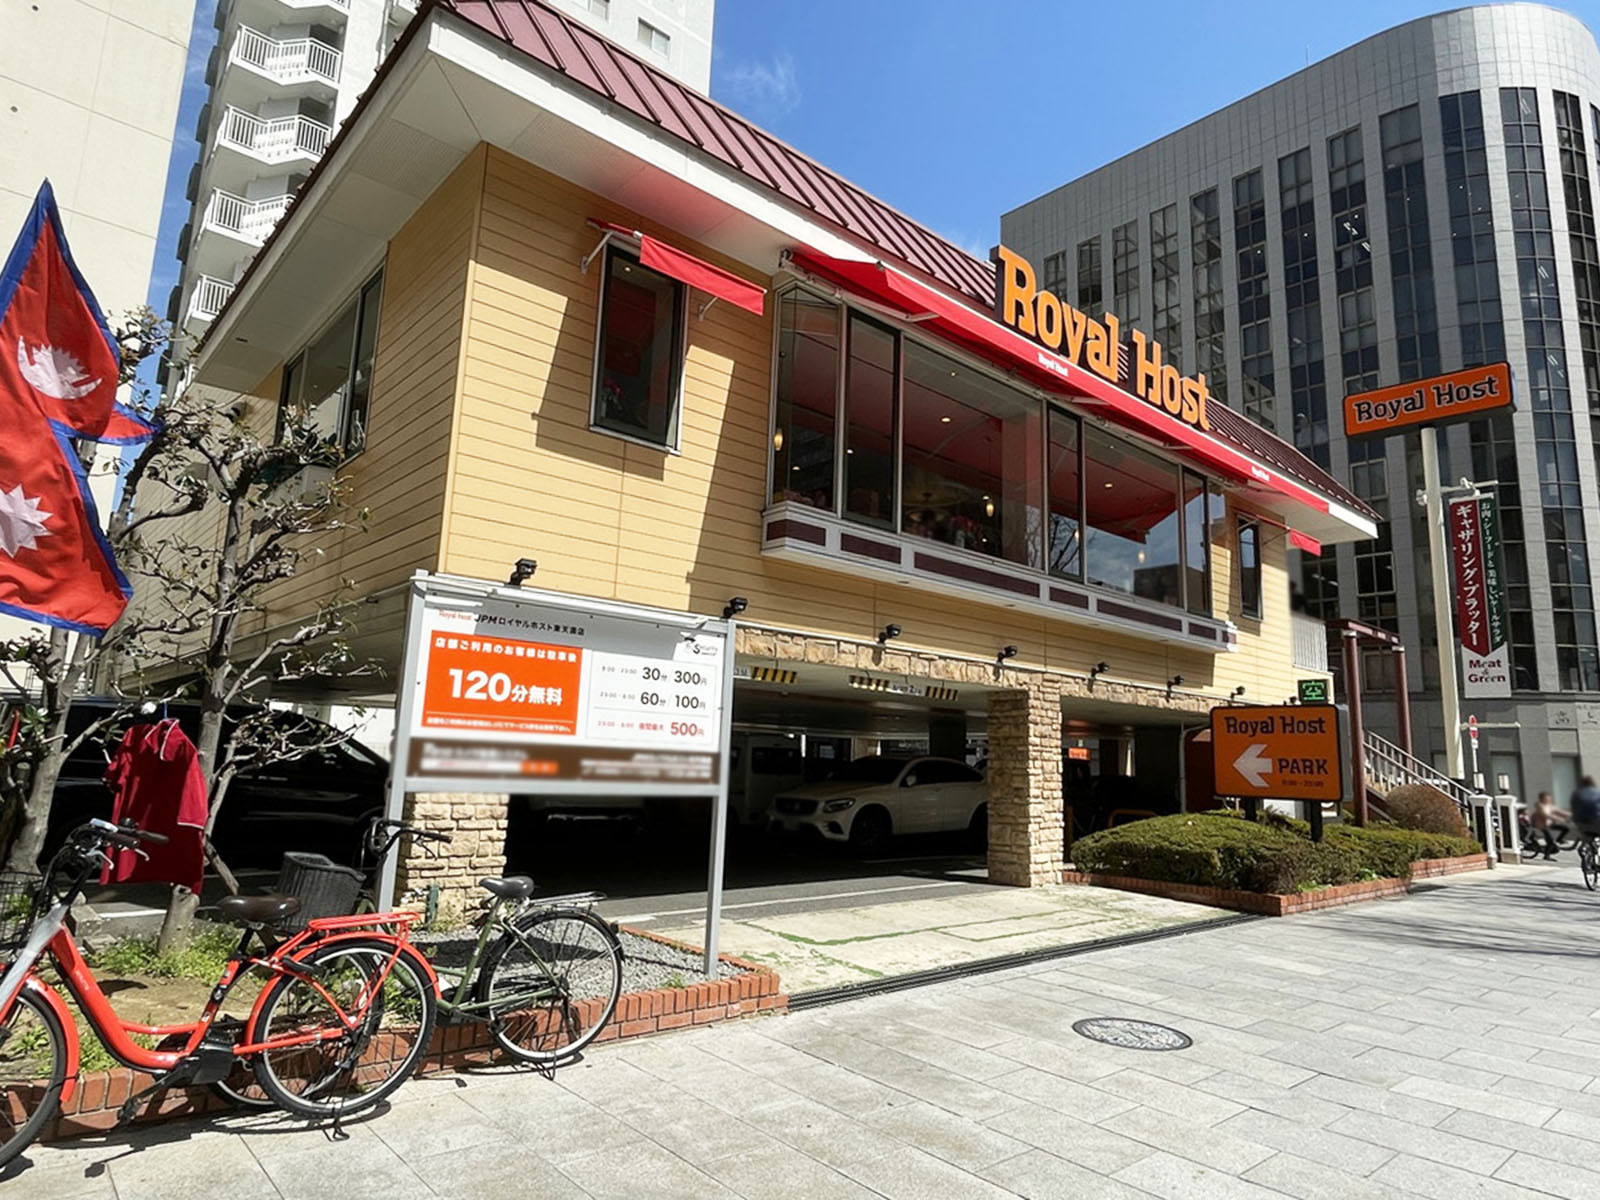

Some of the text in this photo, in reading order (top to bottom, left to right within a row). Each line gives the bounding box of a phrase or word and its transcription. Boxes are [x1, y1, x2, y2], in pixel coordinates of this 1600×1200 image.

[998, 244, 1210, 430] Royal Host
[1354, 376, 1499, 422] Royal Host
[1456, 504, 1480, 646] ギャザリング・プラッター
[1468, 674, 1506, 683] Green
[1469, 659, 1502, 669] Meat
[448, 668, 563, 706] 120分無料
[1224, 716, 1326, 738] Royal Host
[1277, 758, 1329, 775] PARK
